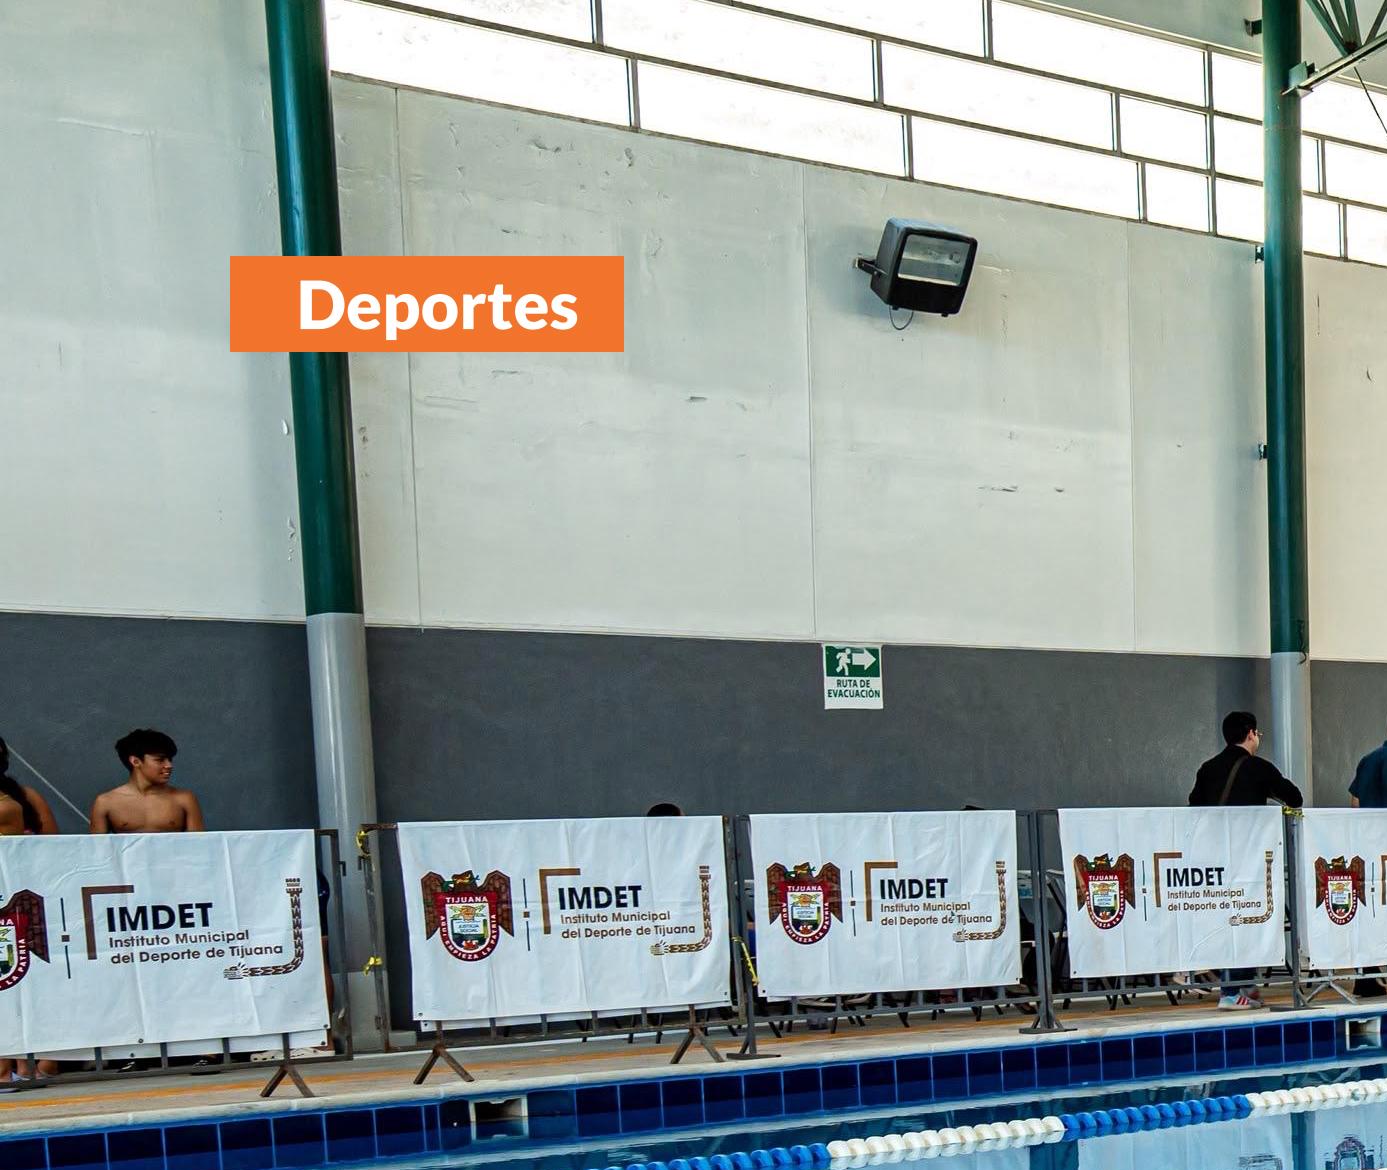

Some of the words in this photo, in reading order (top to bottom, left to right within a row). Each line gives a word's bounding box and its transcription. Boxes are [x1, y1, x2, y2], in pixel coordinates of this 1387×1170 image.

[837, 680, 857, 688] RUTA
[860, 680, 870, 688] DE
[828, 688, 880, 698] EVACUACIÓN
[1167, 868, 1224, 887] IMDET
[880, 879, 948, 899] IMDET
[1168, 890, 1200, 899] Instituto
[1203, 889, 1244, 898] Municipal
[558, 885, 642, 910] IMDET
[881, 903, 920, 912] Instituto
[923, 902, 970, 912] Municipal
[1168, 903, 1181, 911] del
[1183, 902, 1216, 912] Deporte
[1232, 901, 1261, 910] Tijuana
[107, 903, 212, 932] IMDET
[561, 913, 608, 924] Instituto
[612, 911, 670, 923] Municipal
[881, 917, 897, 926] del
[900, 916, 938, 927] Deporte
[941, 915, 953, 924] de
[957, 914, 992, 924] Tijuana
[109, 935, 169, 948] Instituto
[176, 930, 248, 945] Municipal
[562, 928, 580, 938] del
[585, 927, 632, 940] Deporte
[636, 926, 650, 936] de
[654, 924, 695, 936] Tijuana
[111, 952, 134, 964] del
[140, 949, 199, 963] Deporte
[205, 948, 225, 960] de
[231, 945, 283, 959] Tijuana
